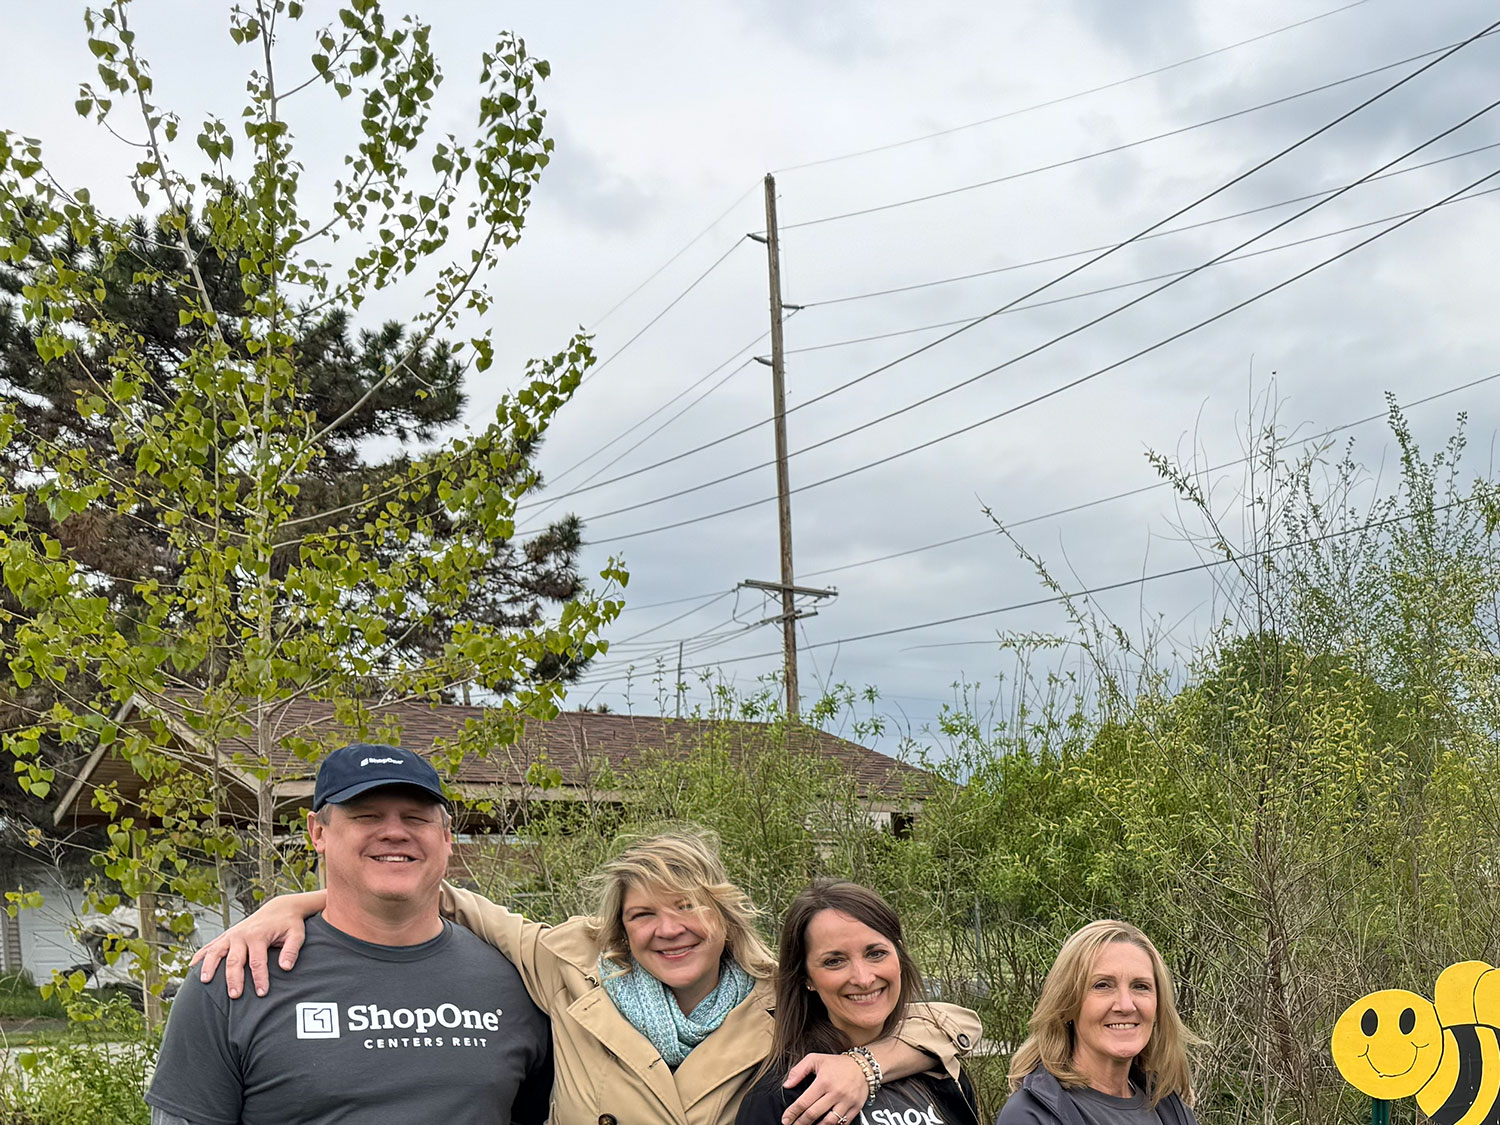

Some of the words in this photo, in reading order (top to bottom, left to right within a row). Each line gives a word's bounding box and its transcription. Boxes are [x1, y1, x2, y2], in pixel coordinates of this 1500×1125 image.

[347, 1003, 499, 1034] ShopOne
[363, 1036, 444, 1050] CENTERS
[452, 1037, 488, 1048] REIT
